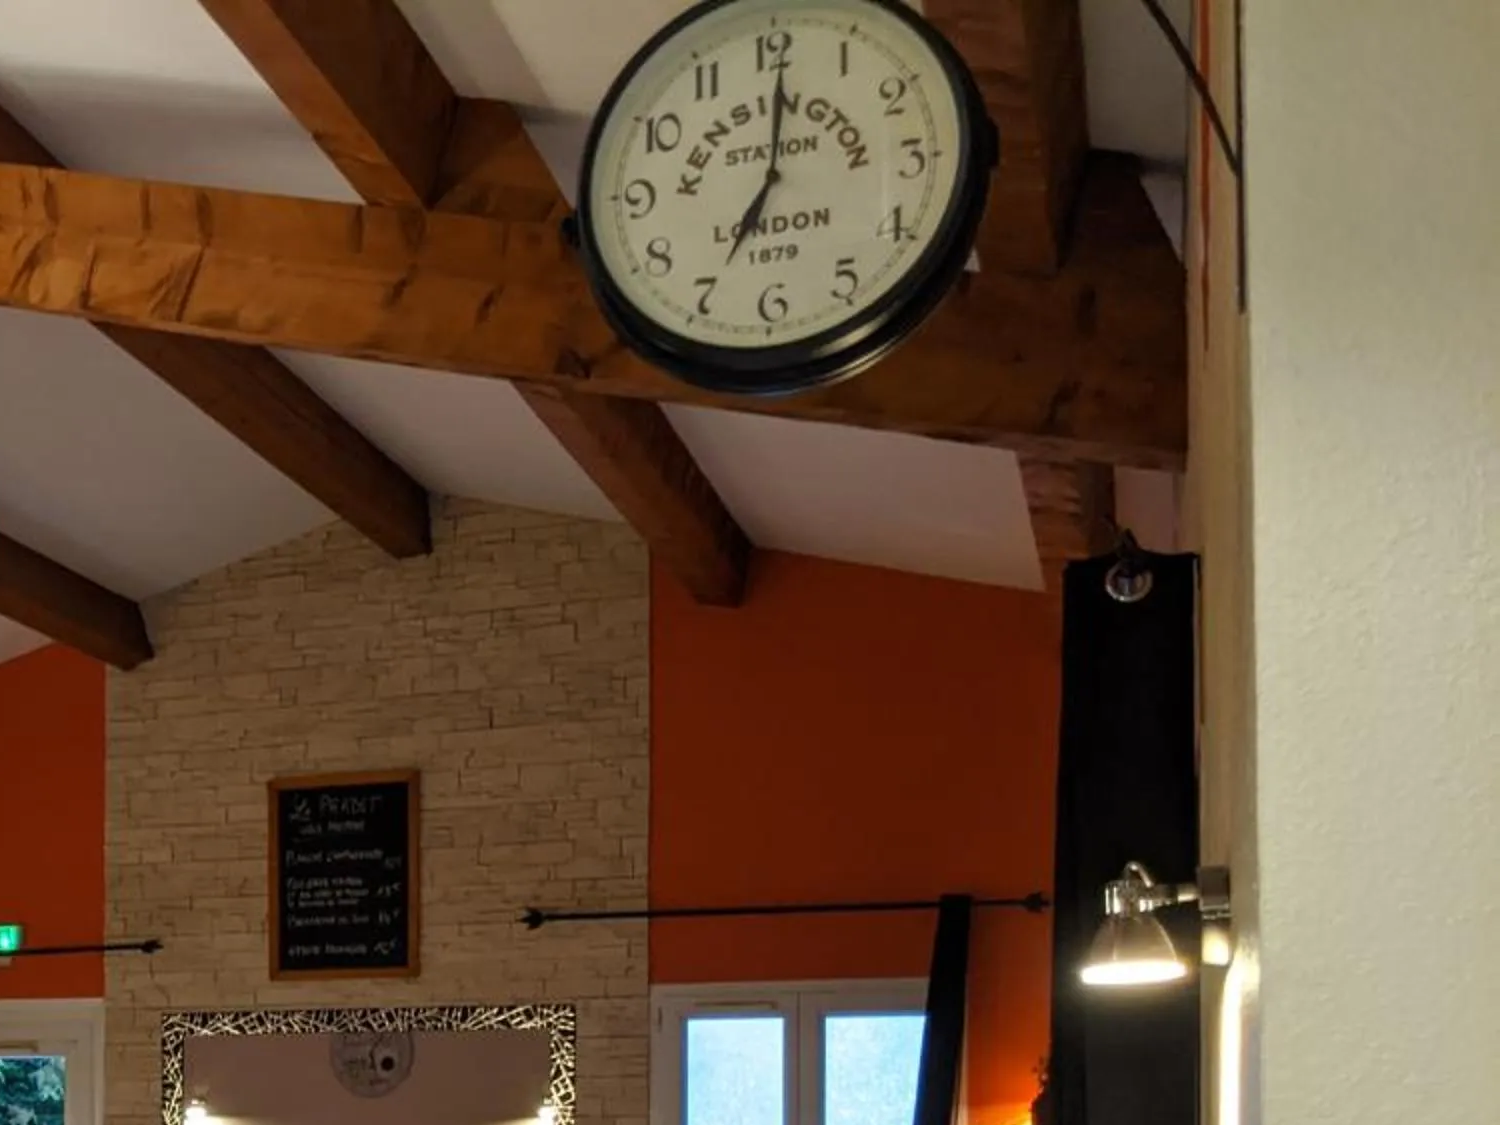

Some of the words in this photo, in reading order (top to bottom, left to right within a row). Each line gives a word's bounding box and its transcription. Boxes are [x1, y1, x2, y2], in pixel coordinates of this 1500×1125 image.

[755, 31, 793, 73] 12
[839, 41, 848, 77] 1
[695, 61, 719, 101] 11
[878, 76, 906, 118] 2
[645, 112, 683, 154] 10
[676, 92, 869, 197] KENSINGTON
[725, 135, 818, 167] STAION
[897, 137, 925, 180] 3
[624, 178, 657, 221] 9
[876, 205, 910, 244] 4
[644, 235, 674, 279] 8
[748, 243, 799, 265] 1879
[693, 276, 718, 316] 7
[830, 257, 860, 302] 5
[757, 283, 789, 324] 6
